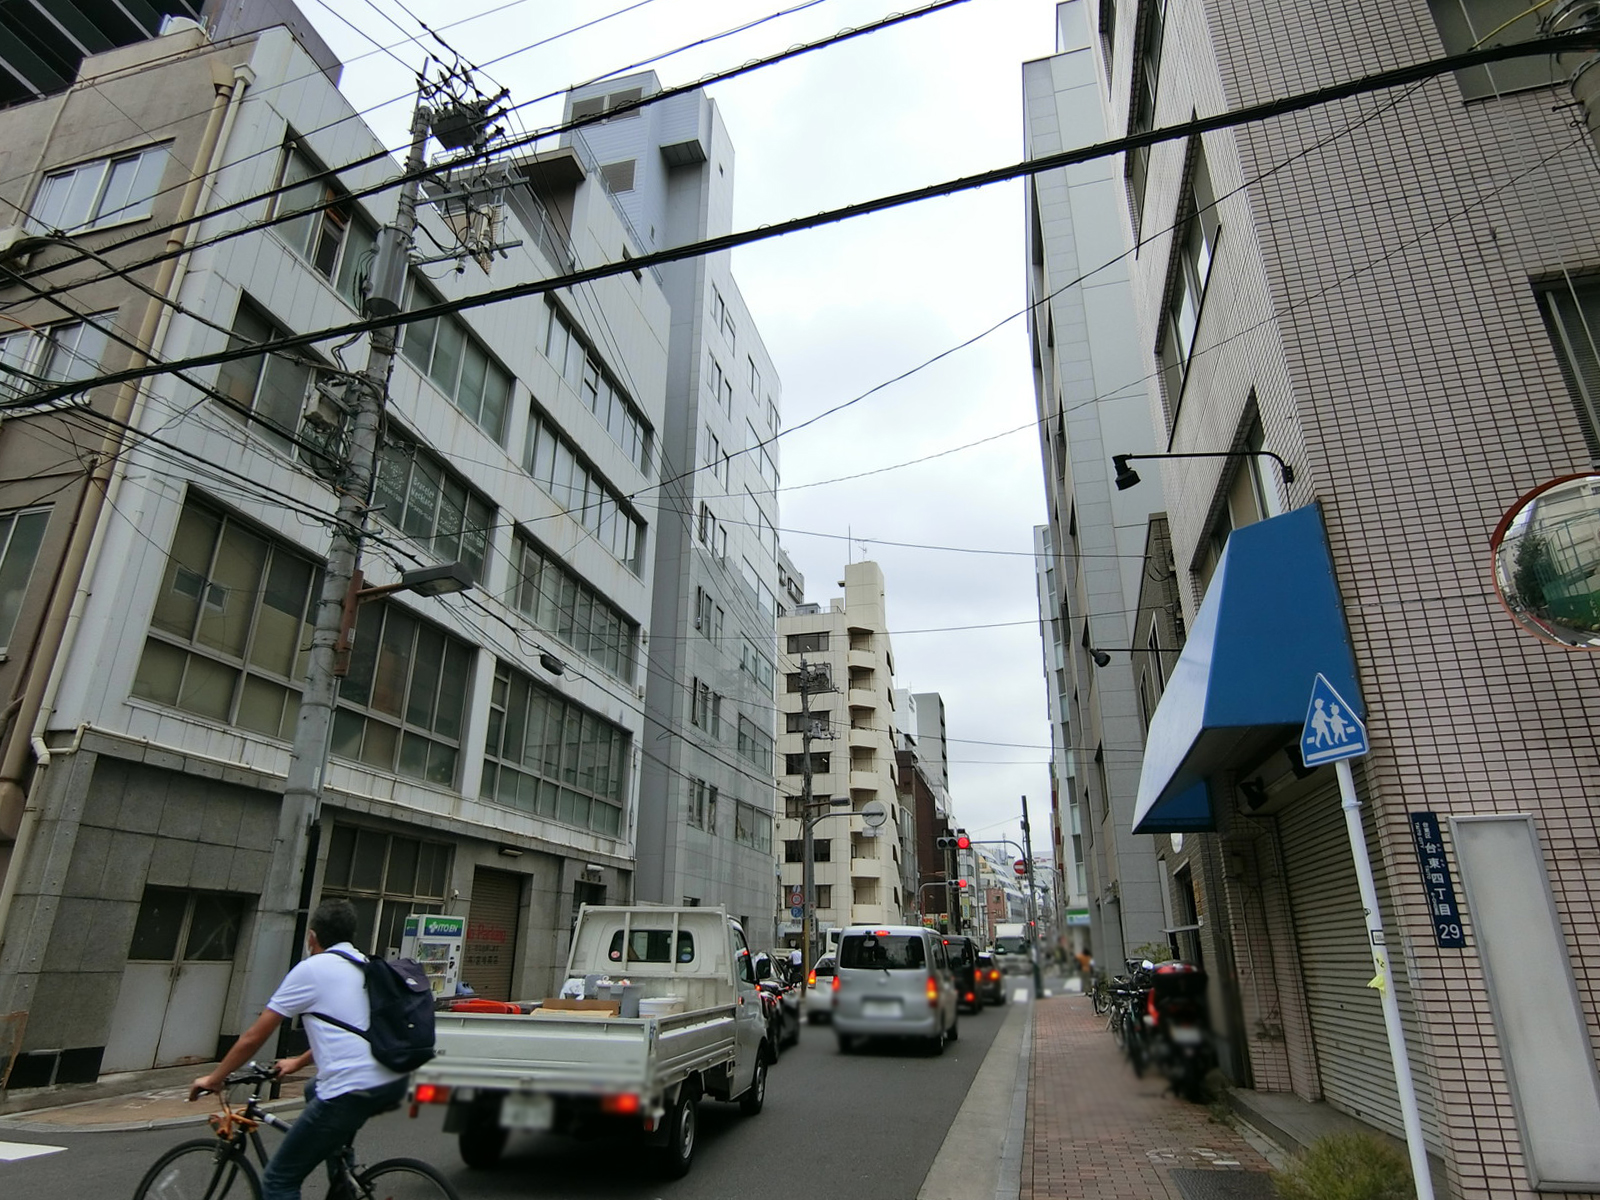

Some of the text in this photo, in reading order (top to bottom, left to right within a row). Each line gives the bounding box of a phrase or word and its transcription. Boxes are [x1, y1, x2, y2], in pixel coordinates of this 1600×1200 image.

[410, 487, 434, 510] Necklace
[1424, 842, 1451, 916] 台東四丁目
[437, 923, 458, 933] ITO EN
[1439, 923, 1461, 940] 29
